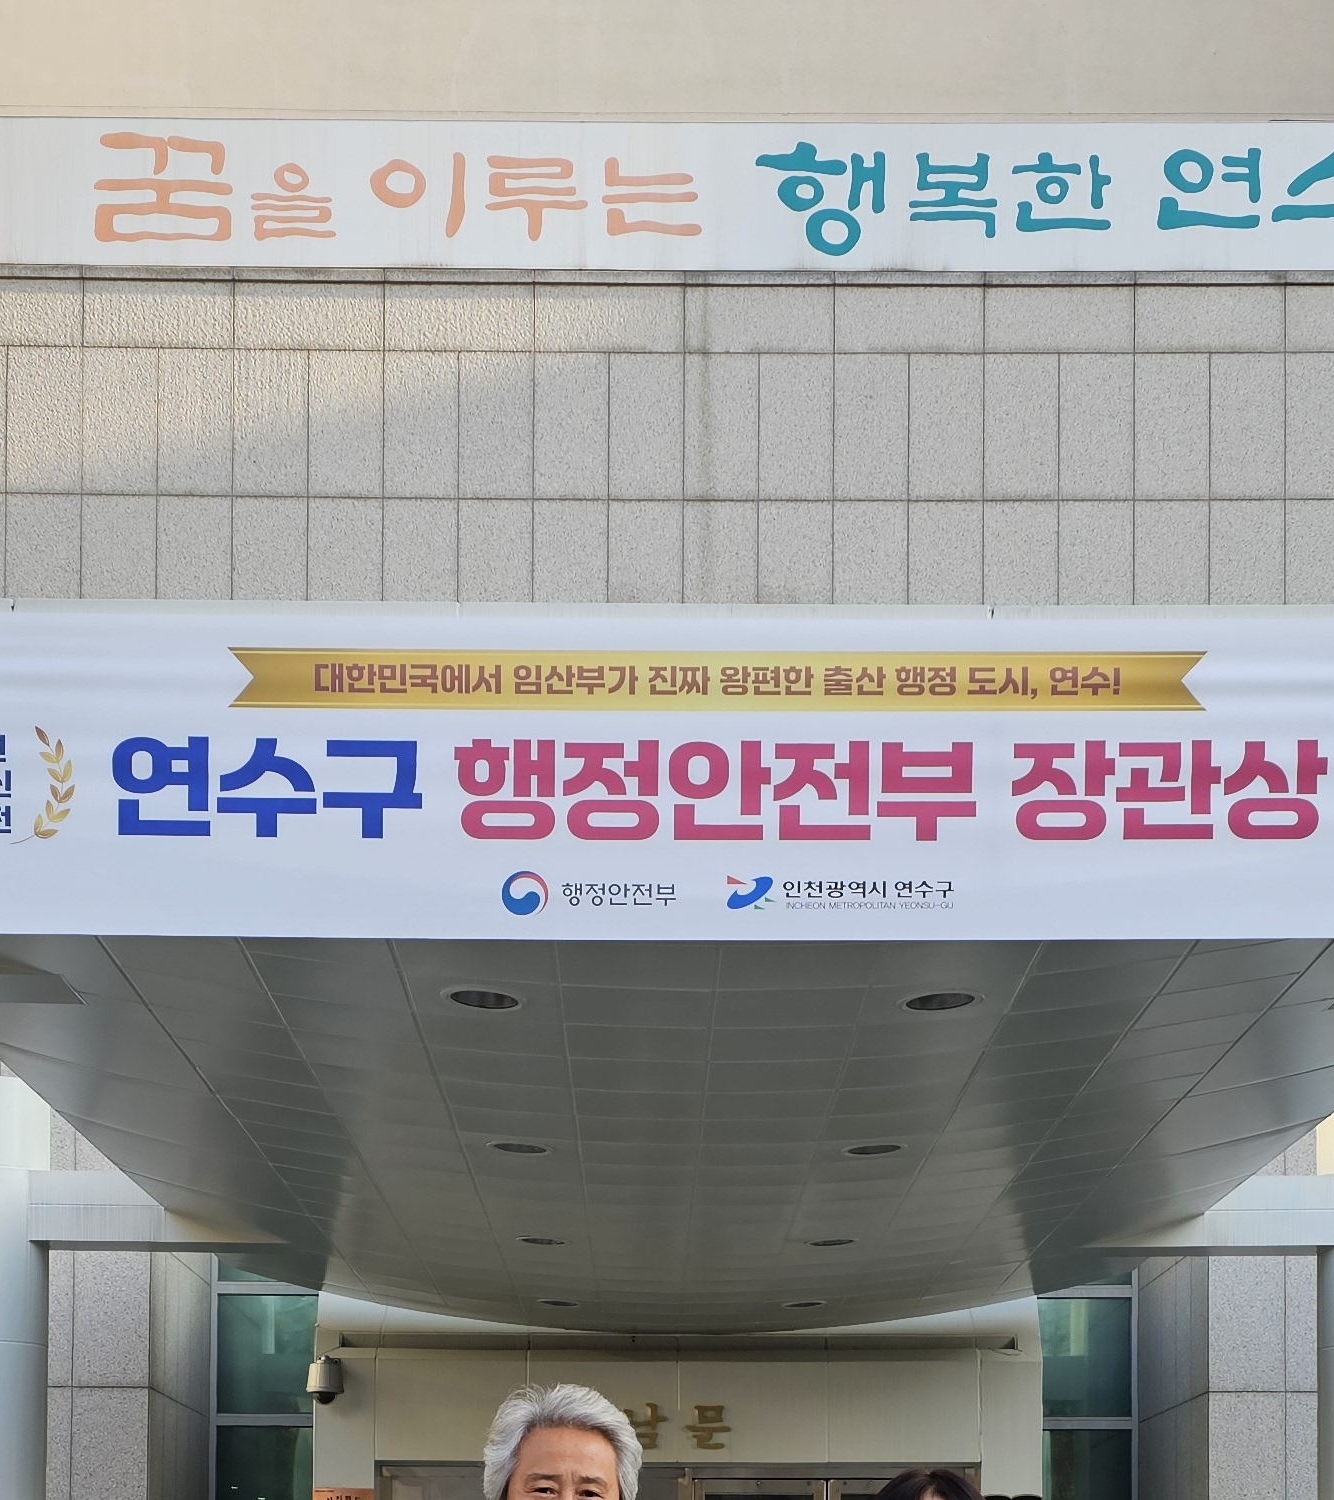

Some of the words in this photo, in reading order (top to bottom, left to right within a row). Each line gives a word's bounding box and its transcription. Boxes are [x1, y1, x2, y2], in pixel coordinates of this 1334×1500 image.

[93, 132, 336, 242] 꿈을
[369, 151, 703, 241] 이루는
[755, 141, 1112, 257] 행복한
[313, 662, 502, 695] 대한민국에서
[513, 664, 638, 695] 임산부가
[648, 665, 711, 696] 진짜
[720, 665, 815, 697] 왕편한
[824, 665, 886, 696] 출산
[895, 666, 957, 696] 행정
[967, 666, 1038, 700] 도시,
[1050, 666, 1121, 696] 연수!
[112, 736, 423, 838] 연수구
[454, 738, 977, 842] 행정안전부
[1011, 739, 1329, 841] 장관상
[561, 882, 677, 907] 행정안전부
[782, 880, 887, 899] 인천광역시
[894, 880, 955, 899] 연수구
[786, 901, 826, 910] INCHEON
[829, 901, 896, 910] METROPOLITAN
[899, 901, 954, 910] YEONSU-GU
